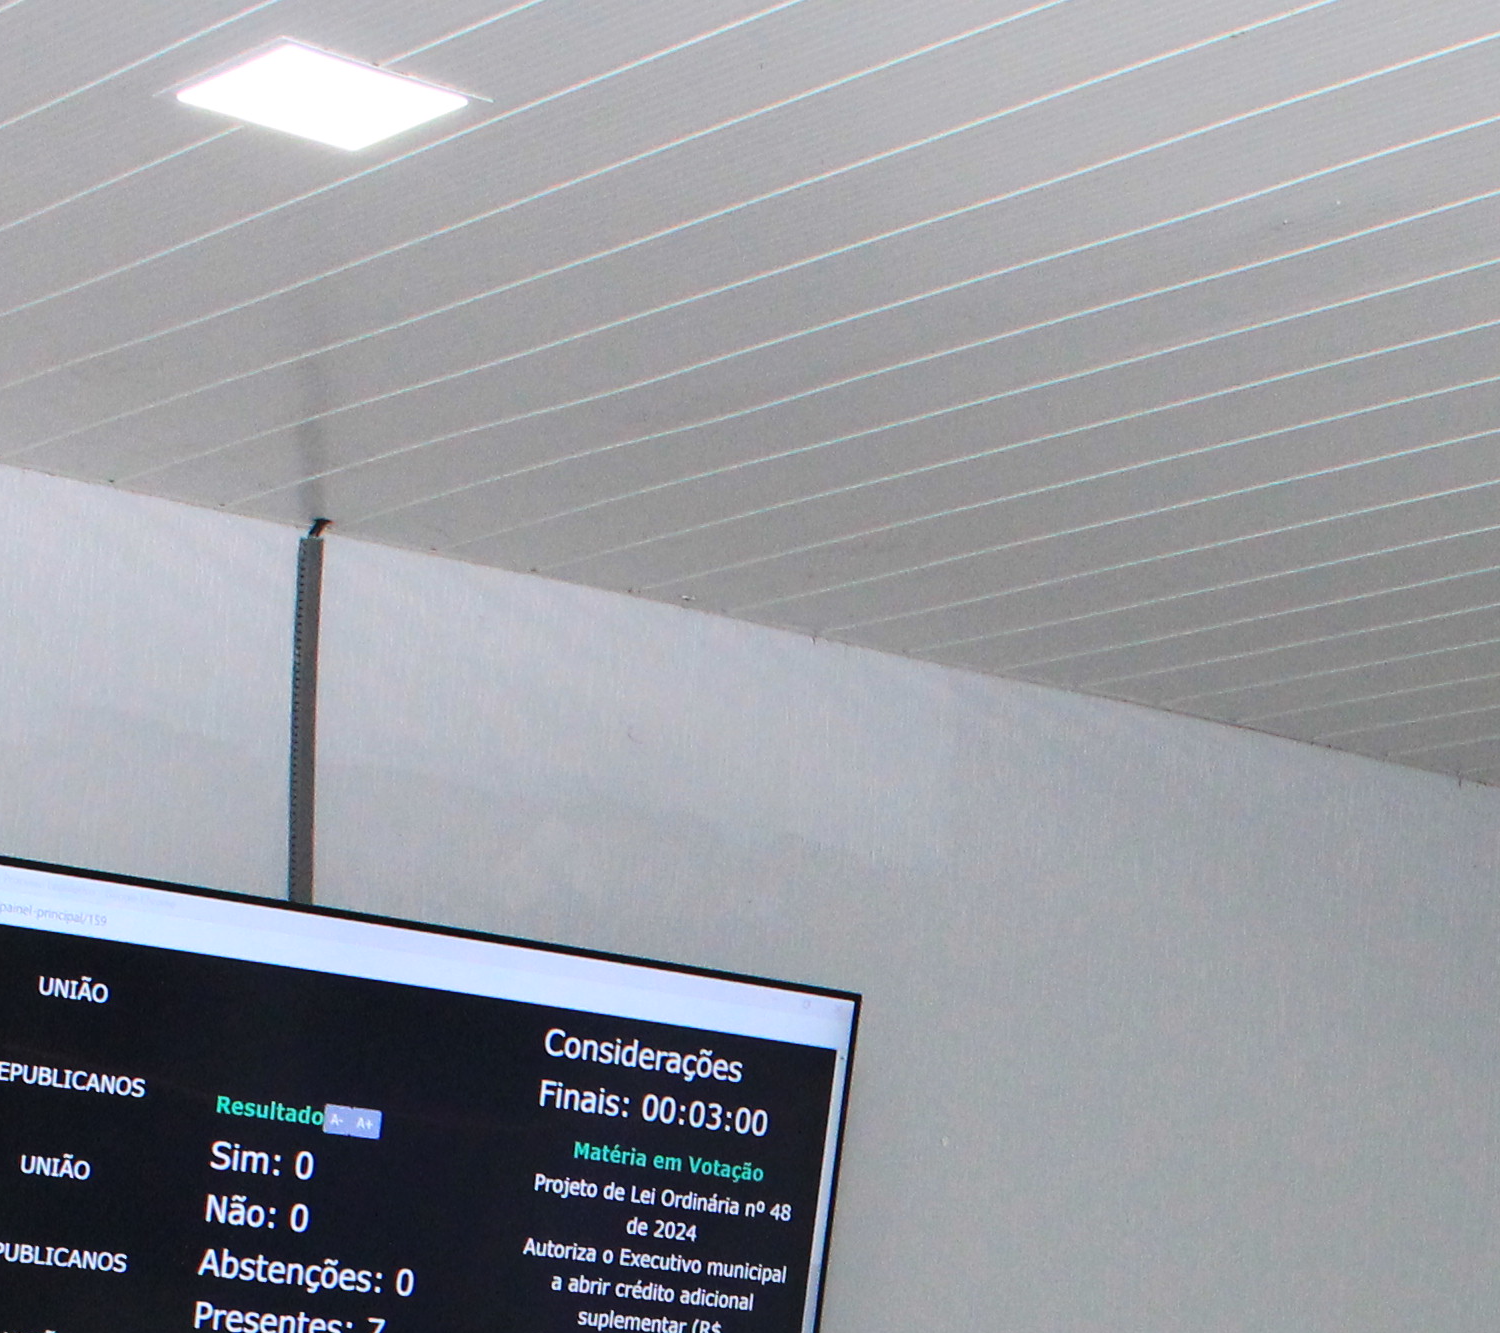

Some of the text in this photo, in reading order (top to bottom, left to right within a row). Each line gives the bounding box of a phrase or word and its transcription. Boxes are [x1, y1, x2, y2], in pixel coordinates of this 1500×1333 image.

[38, 975, 109, 1004] UNIÃO
[544, 1027, 743, 1083] Considerações
[216, 1095, 324, 1128] Resultado
[538, 1078, 768, 1137] Finais: 00:03:00
[20, 1152, 91, 1180] UNIÃO
[209, 1139, 314, 1180] Sim: 0
[573, 1140, 764, 1183] Matéria em Votação
[204, 1193, 310, 1233] Não: 0
[533, 1172, 598, 1198] Projeto
[602, 1181, 626, 1202] de
[630, 1184, 656, 1205] Lei
[660, 1188, 739, 1215] Ordinária
[769, 1202, 792, 1222] 48
[625, 1216, 697, 1242] de 2024
[197, 1247, 415, 1297] Abstenções: 0
[522, 1237, 787, 1285] Autoriza o Executivo municipal
[550, 1274, 754, 1311] a abrir crédito adicional
